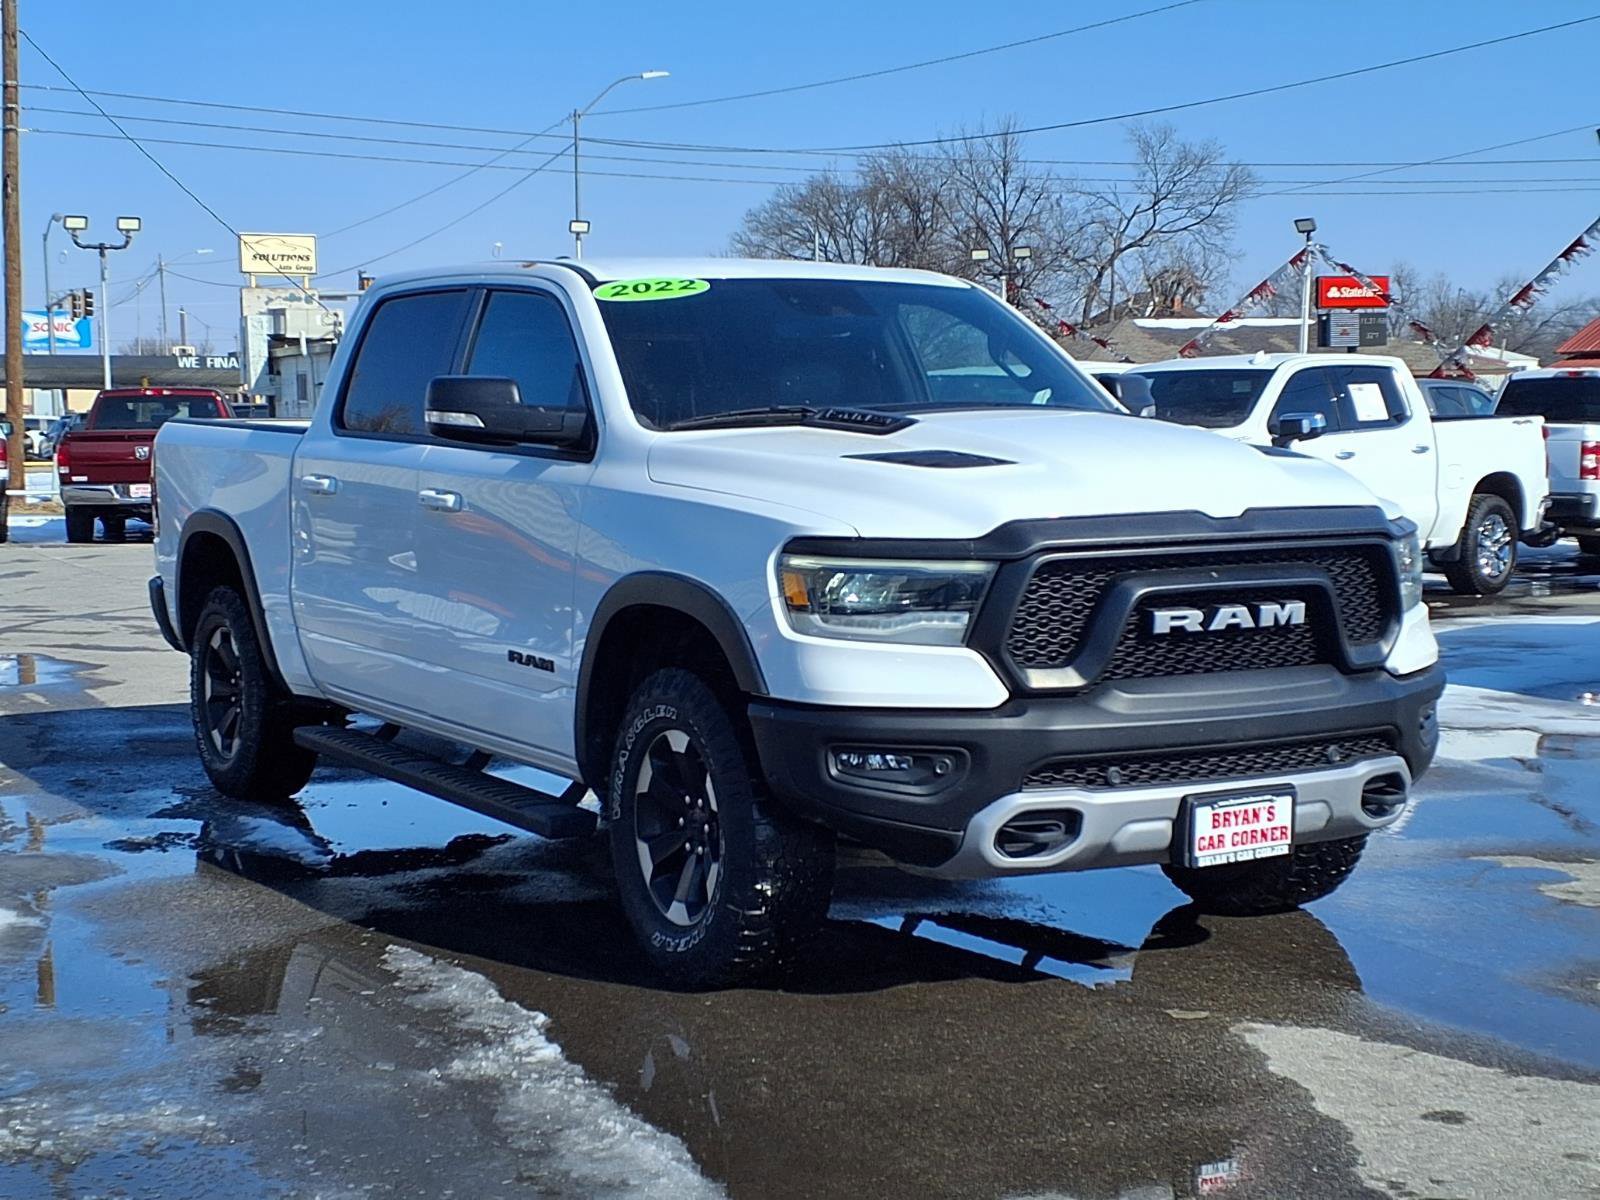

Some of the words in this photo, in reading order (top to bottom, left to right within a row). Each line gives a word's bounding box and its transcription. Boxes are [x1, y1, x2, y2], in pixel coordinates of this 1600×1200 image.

[252, 253, 311, 262] SOLUTIONS
[610, 279, 697, 298] 2022
[32, 322, 72, 332] SONIC
[178, 356, 200, 368] WE
[1152, 601, 1306, 634] RAM
[507, 649, 555, 673] RAM
[1211, 805, 1276, 829] BRYAN'S
[1197, 834, 1226, 851] CAR
[1231, 826, 1289, 847] CORNER
